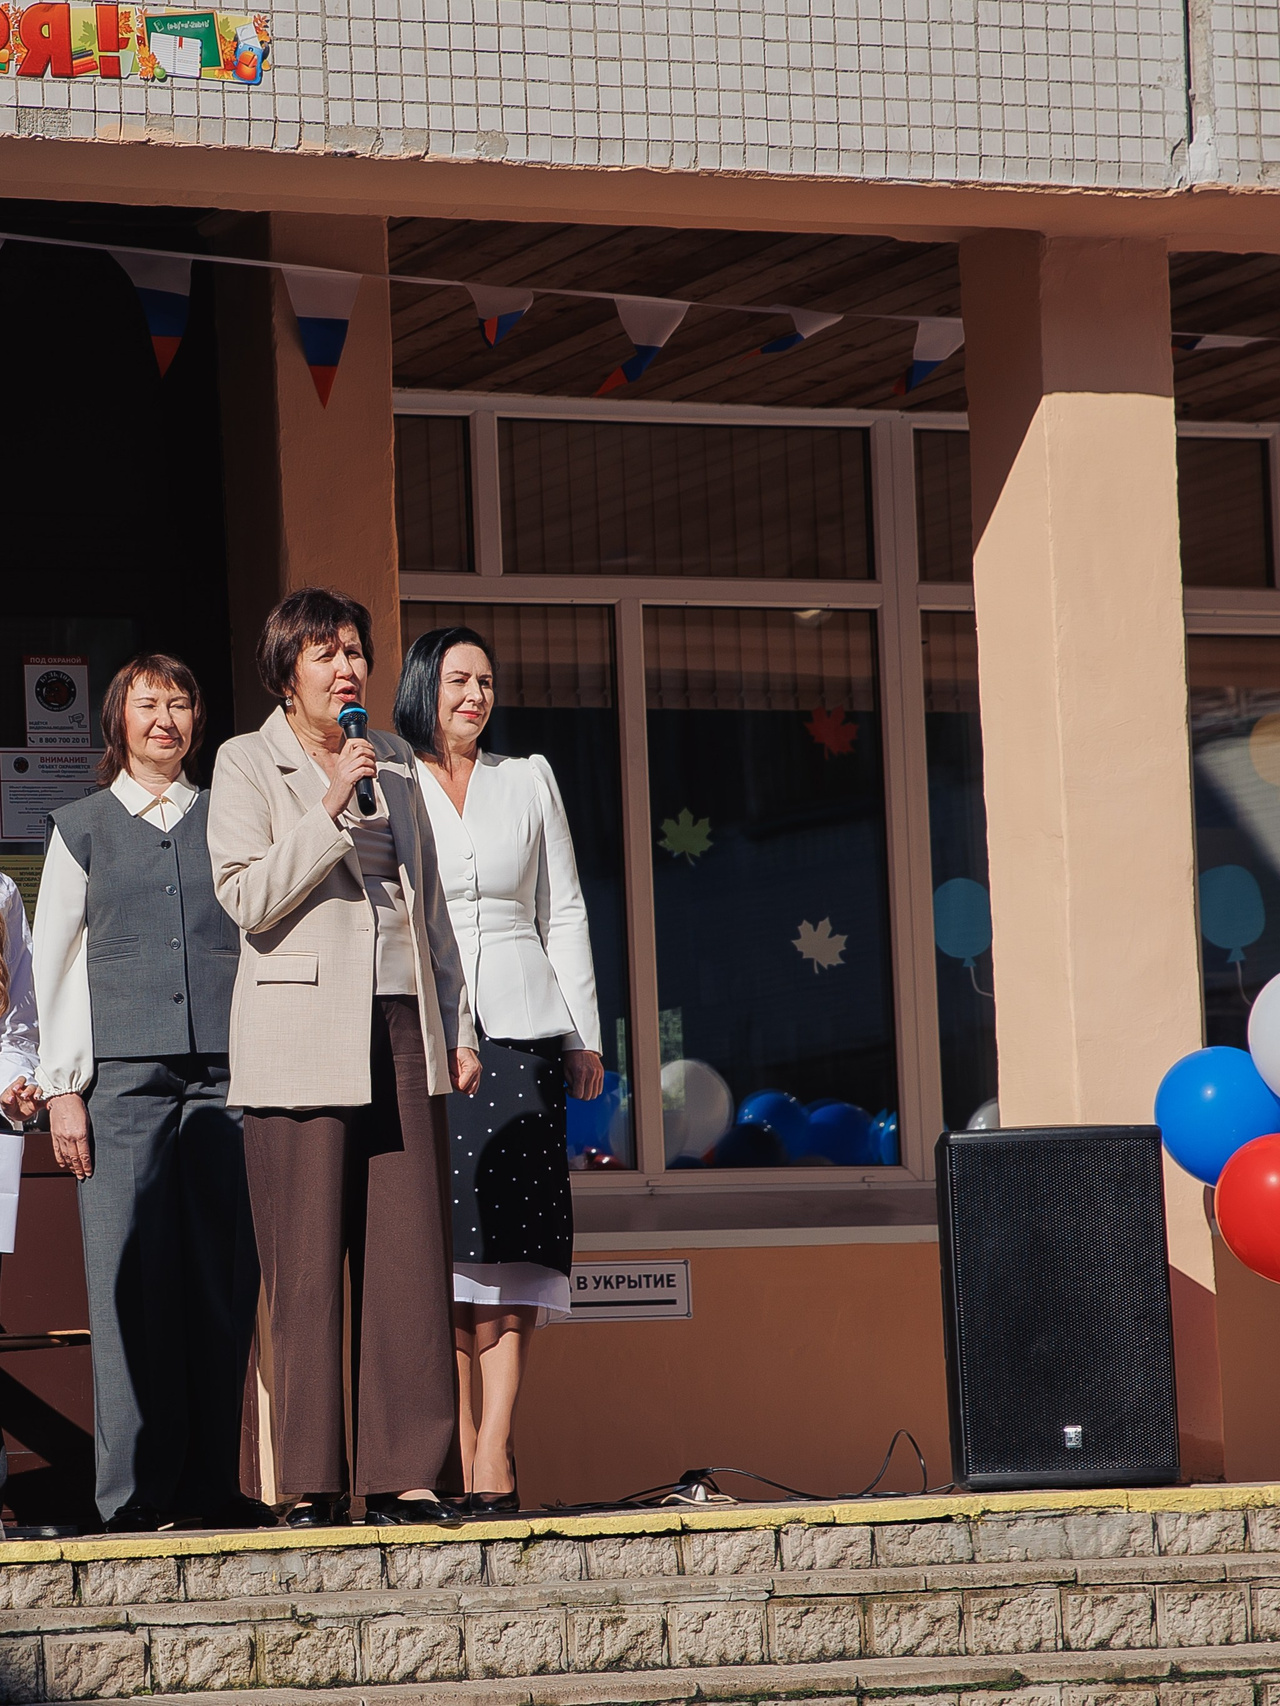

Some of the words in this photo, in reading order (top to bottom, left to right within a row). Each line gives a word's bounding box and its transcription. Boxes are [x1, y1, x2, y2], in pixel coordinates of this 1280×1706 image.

[47, 656, 82, 664] ОХРАНОЙ
[576, 1276, 588, 1290] В
[592, 1273, 677, 1290] УКРЫТИЕ
